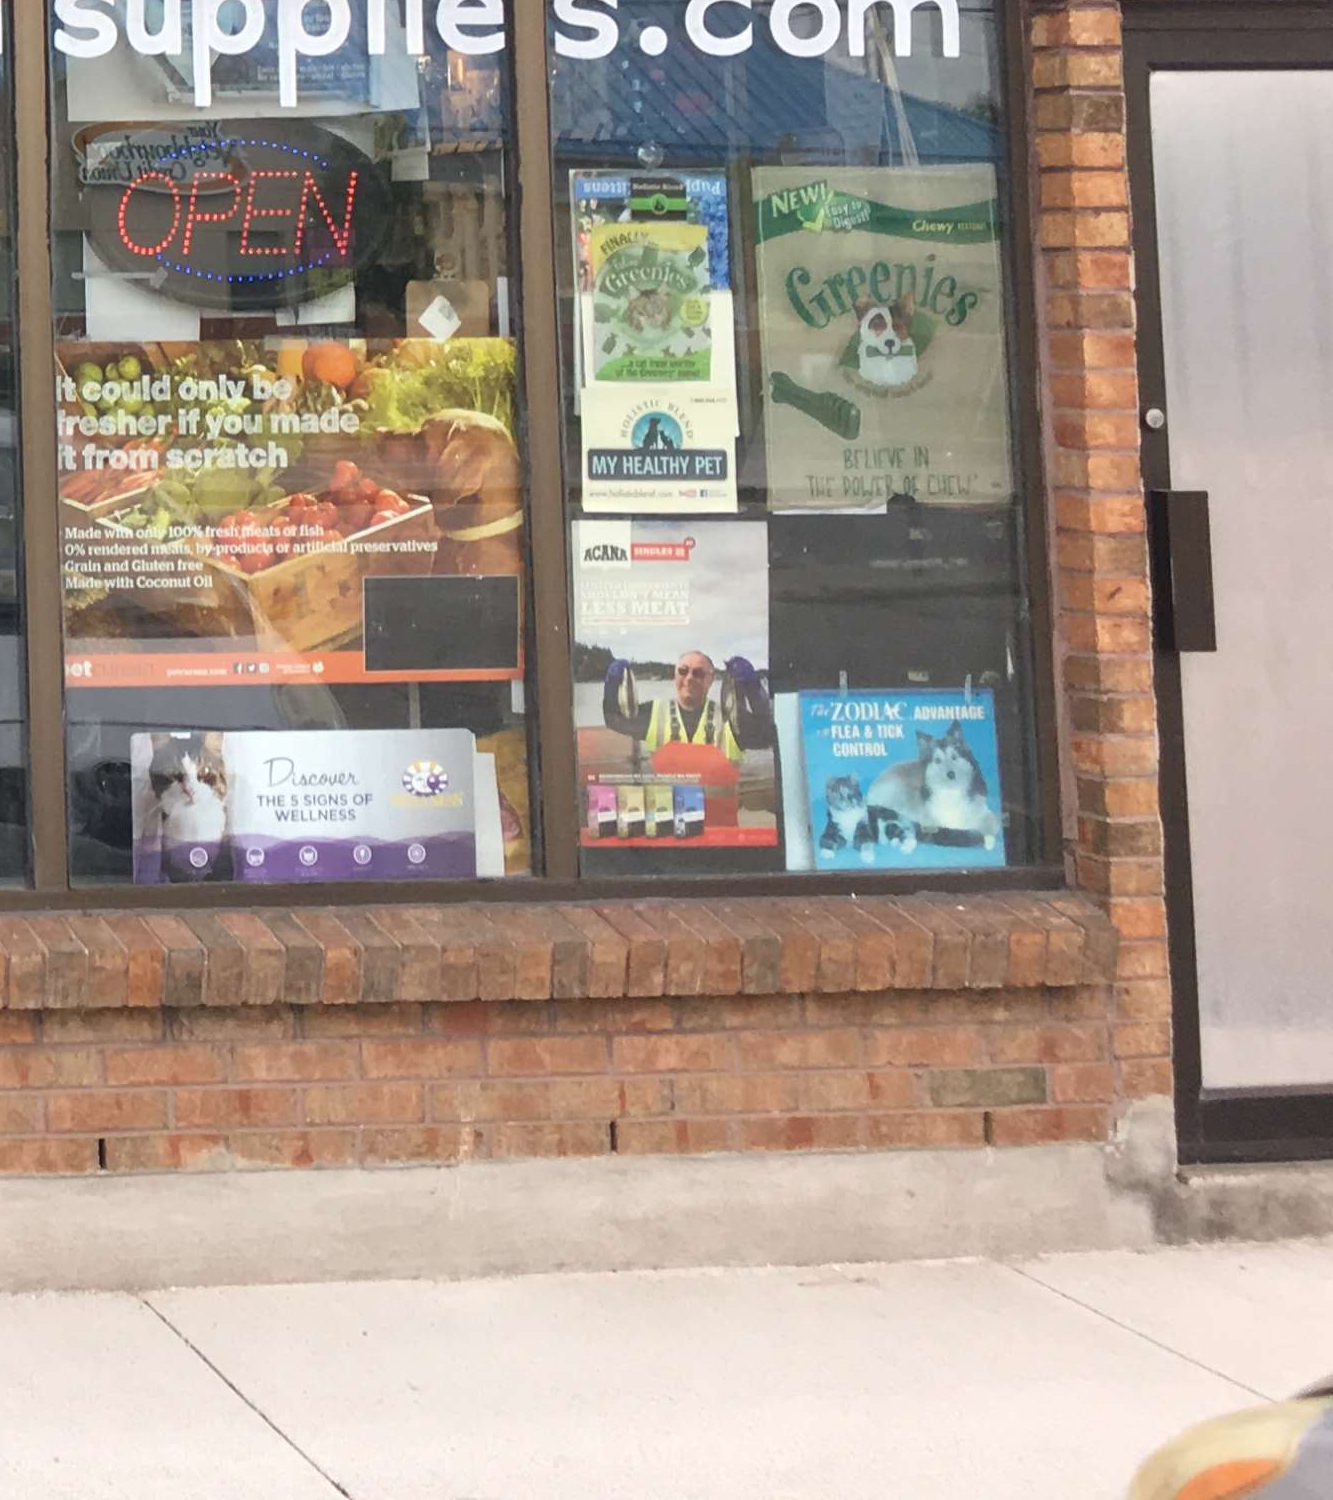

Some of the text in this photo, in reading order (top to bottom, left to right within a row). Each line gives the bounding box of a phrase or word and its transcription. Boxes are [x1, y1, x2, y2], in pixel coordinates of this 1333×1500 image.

[118, 169, 359, 257] OPEN
[786, 253, 978, 329] Greenies
[82, 375, 171, 403] could
[178, 375, 245, 408] only
[252, 374, 293, 401] be
[58, 407, 360, 442] fresher if you made
[82, 442, 289, 471] from scratch
[592, 456, 723, 475] MY HEALTHY PET
[844, 447, 930, 470] BELIEVE IN
[65, 524, 324, 543] Made with only 100% fresh meats fish
[65, 543, 85, 556] 0%
[88, 543, 148, 556] rendered
[197, 541, 273, 558] by-products
[276, 544, 290, 554] or
[293, 540, 348, 553] artificial
[350, 540, 438, 555] preservatives
[584, 544, 629, 561] ACANA
[65, 560, 204, 573] Grain and Gluten free
[65, 575, 213, 588] Made with Coconut Oil
[830, 702, 986, 721] ZODIAC ADVANTAGE
[832, 724, 861, 739] FLEA
[877, 724, 905, 739] TICK
[833, 742, 888, 758] CONTROL
[264, 757, 360, 787] Discover
[257, 793, 374, 807] THE 5 SIGNS OF
[275, 809, 357, 822] WELLNESS
